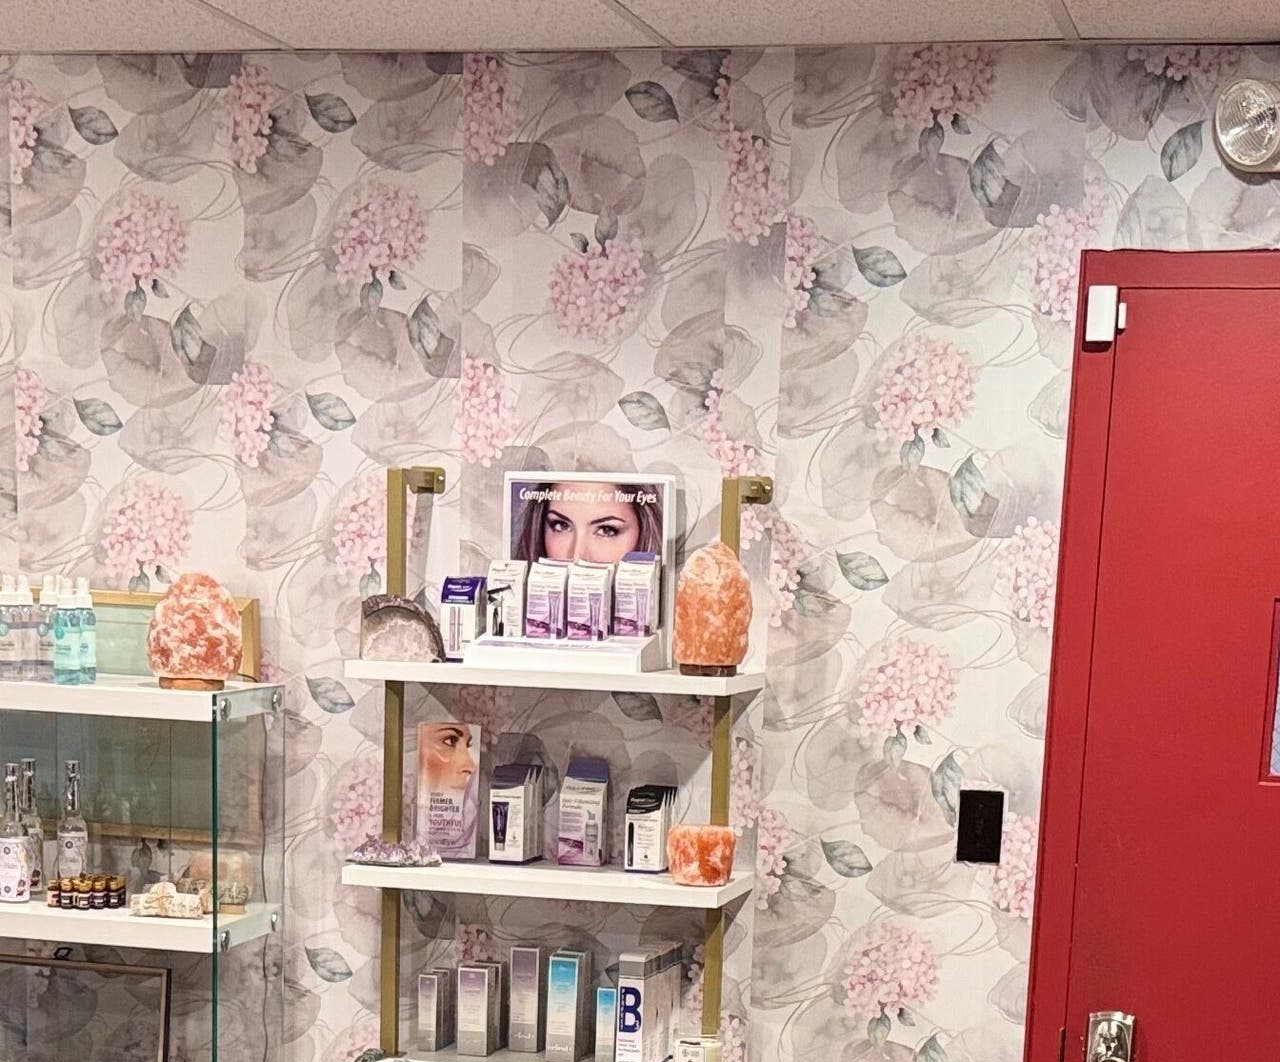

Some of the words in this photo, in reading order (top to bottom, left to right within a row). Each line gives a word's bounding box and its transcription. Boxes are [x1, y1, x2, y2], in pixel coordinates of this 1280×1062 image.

[519, 487, 562, 503] Complete
[563, 490, 596, 503] Beauty
[599, 491, 613, 502] For
[614, 490, 635, 503] Your
[636, 491, 657, 506] Eyes
